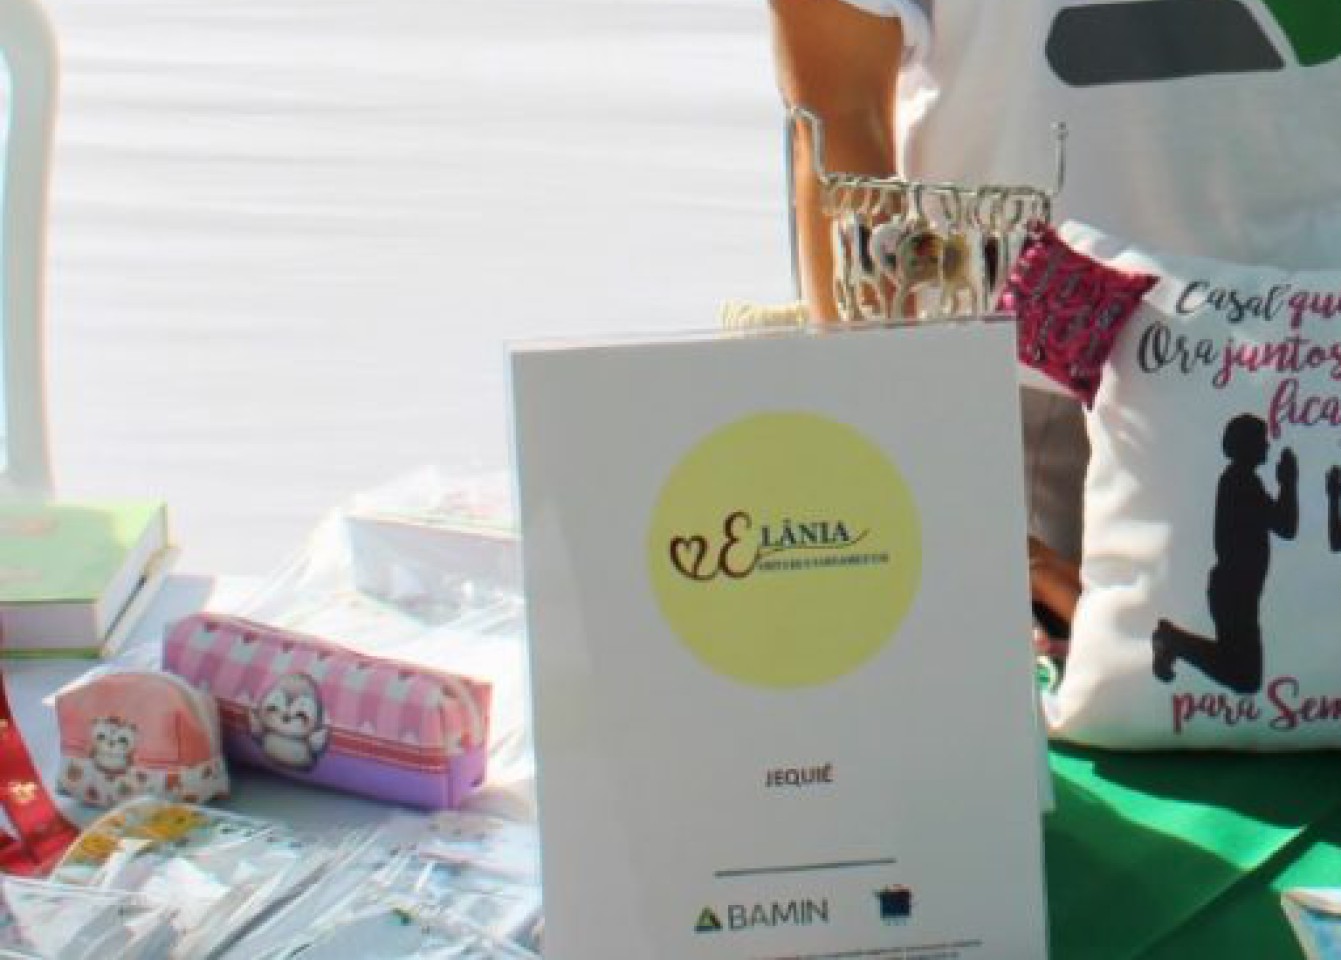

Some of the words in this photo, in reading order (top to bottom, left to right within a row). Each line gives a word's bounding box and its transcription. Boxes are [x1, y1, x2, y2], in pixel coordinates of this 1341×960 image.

[1176, 280, 1291, 324] Casal
[1137, 320, 1217, 374] Ora
[1171, 691, 1261, 736] para
[764, 762, 834, 788] JEQUIÉ
[727, 897, 830, 931] BAMIN
